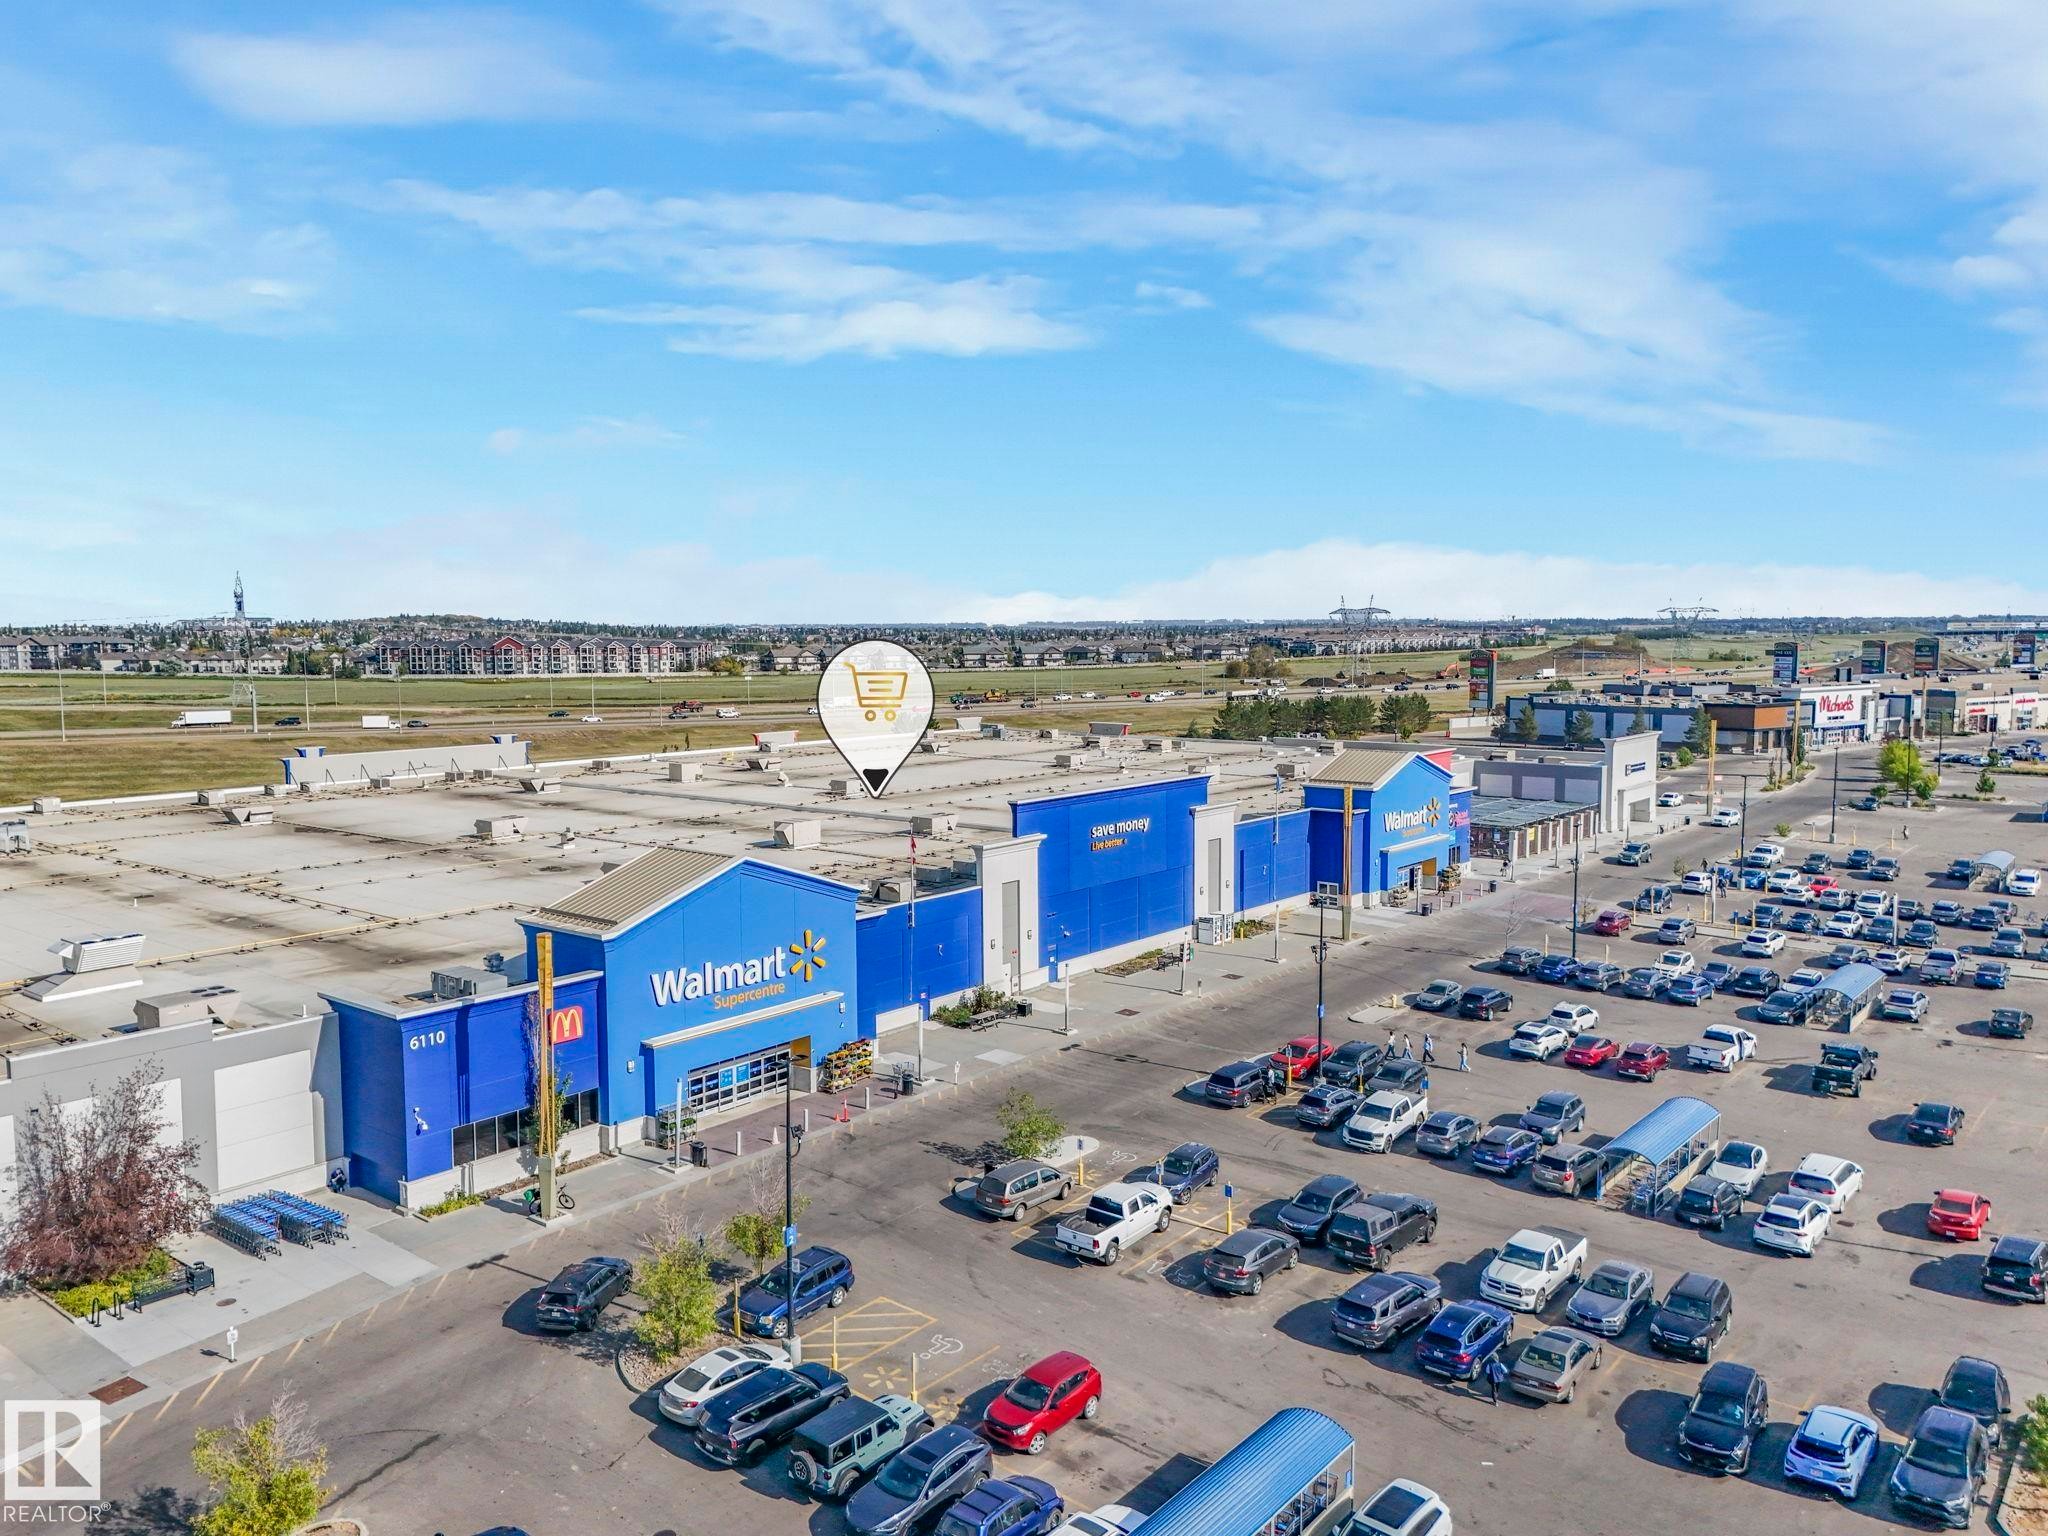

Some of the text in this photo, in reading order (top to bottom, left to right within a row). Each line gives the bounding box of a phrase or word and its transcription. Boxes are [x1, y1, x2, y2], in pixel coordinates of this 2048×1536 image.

[1819, 694, 1854, 713] Michaels
[1091, 817, 1149, 838] save money
[1384, 805, 1429, 832] Walmart
[1091, 840, 1104, 851] Live
[650, 946, 786, 1007] Walmart
[714, 982, 786, 1010] Supercentre
[409, 1030, 446, 1050] 6110
